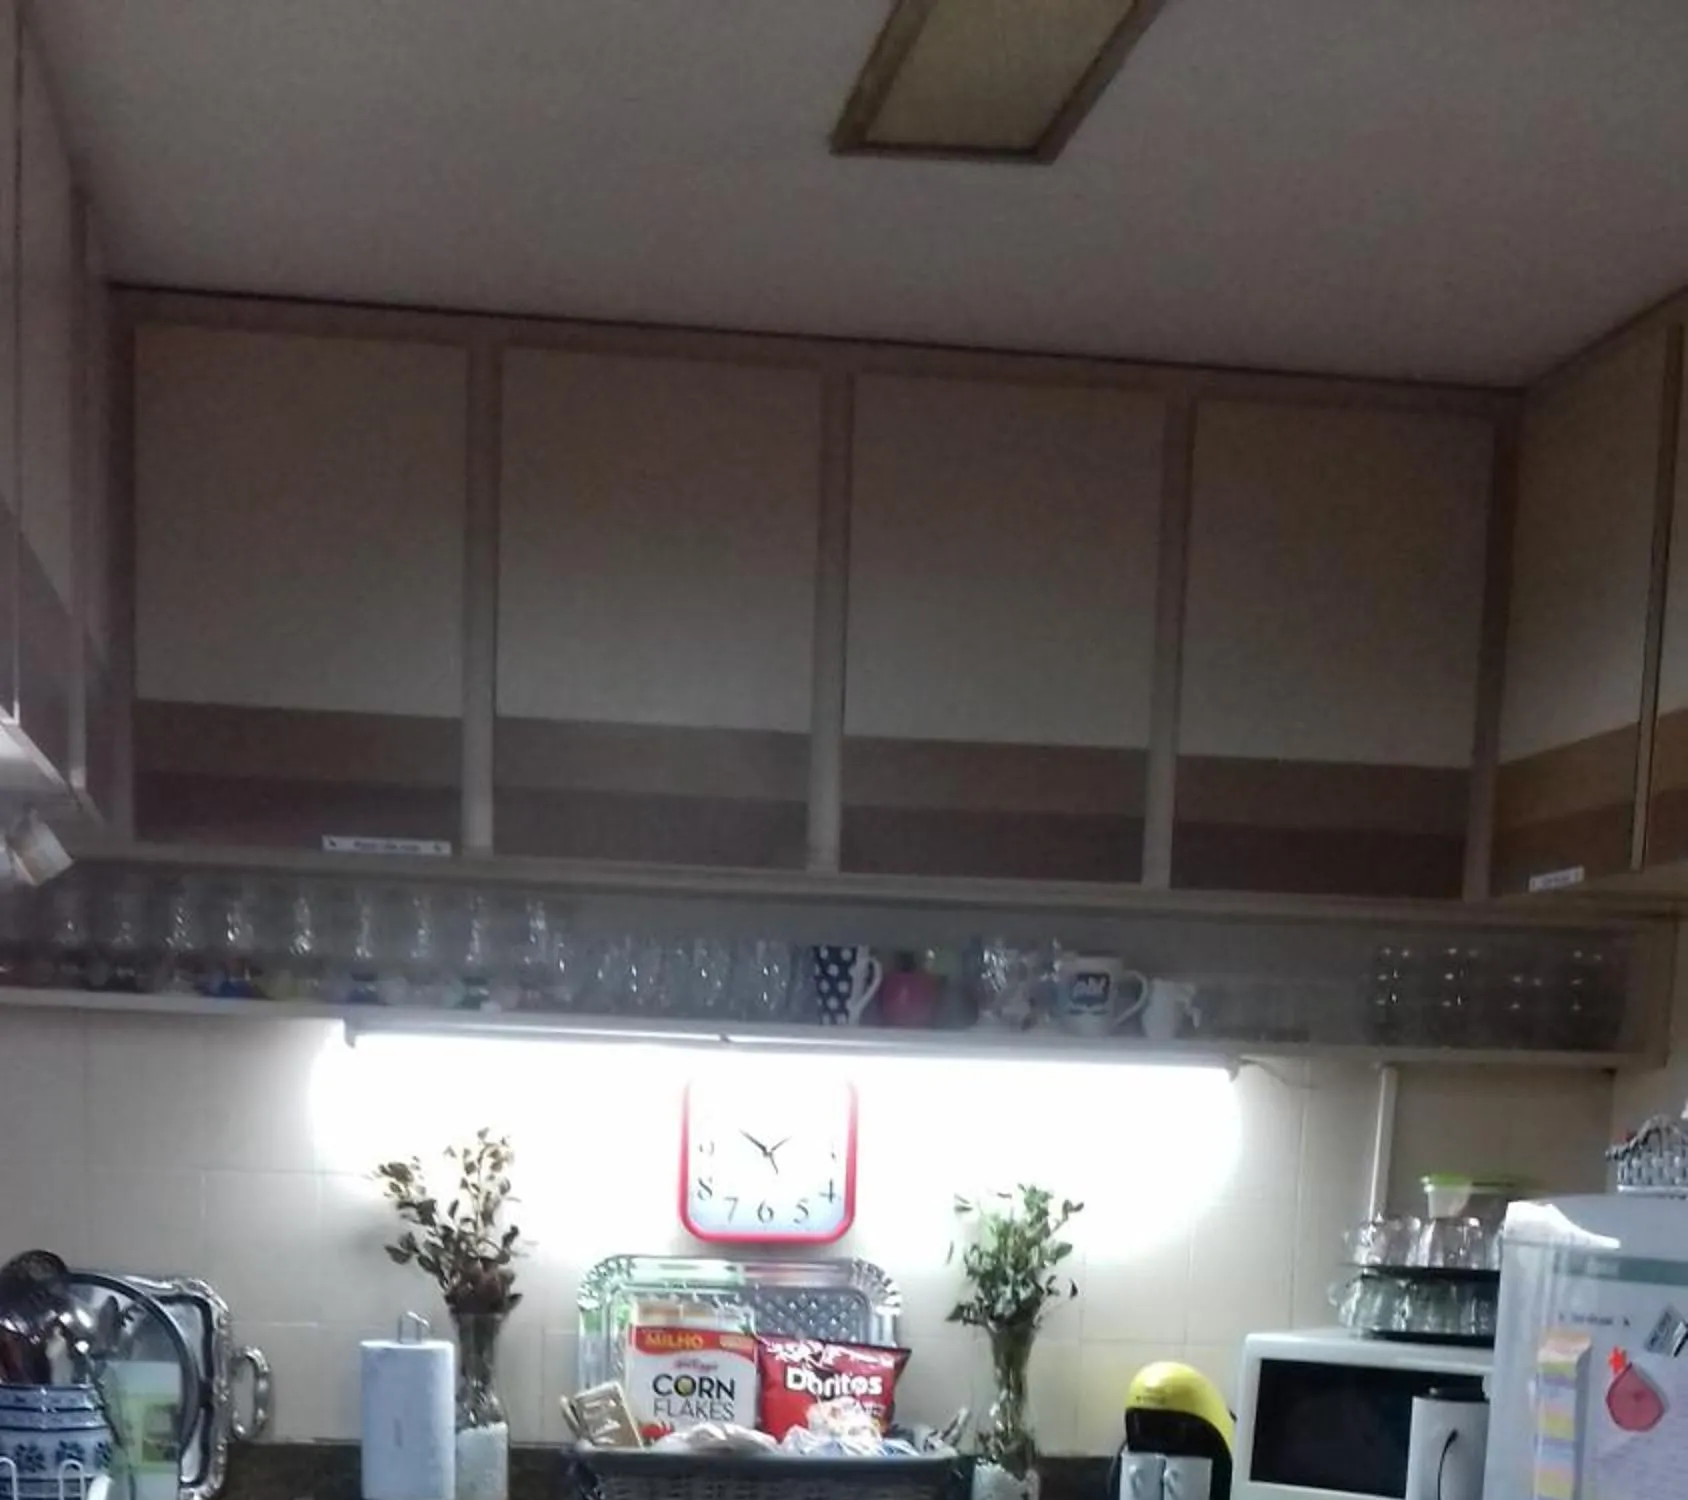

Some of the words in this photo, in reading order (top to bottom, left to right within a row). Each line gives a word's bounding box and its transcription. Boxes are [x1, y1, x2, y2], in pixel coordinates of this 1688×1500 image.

[724, 1196, 739, 1224] 7
[757, 1200, 774, 1224] 6
[793, 1198, 809, 1224] 5
[819, 1177, 841, 1204] 4
[645, 1331, 704, 1349] MILHO
[652, 1373, 735, 1401] CORN
[786, 1364, 882, 1398] Doritos
[653, 1397, 735, 1421] FLAKES
